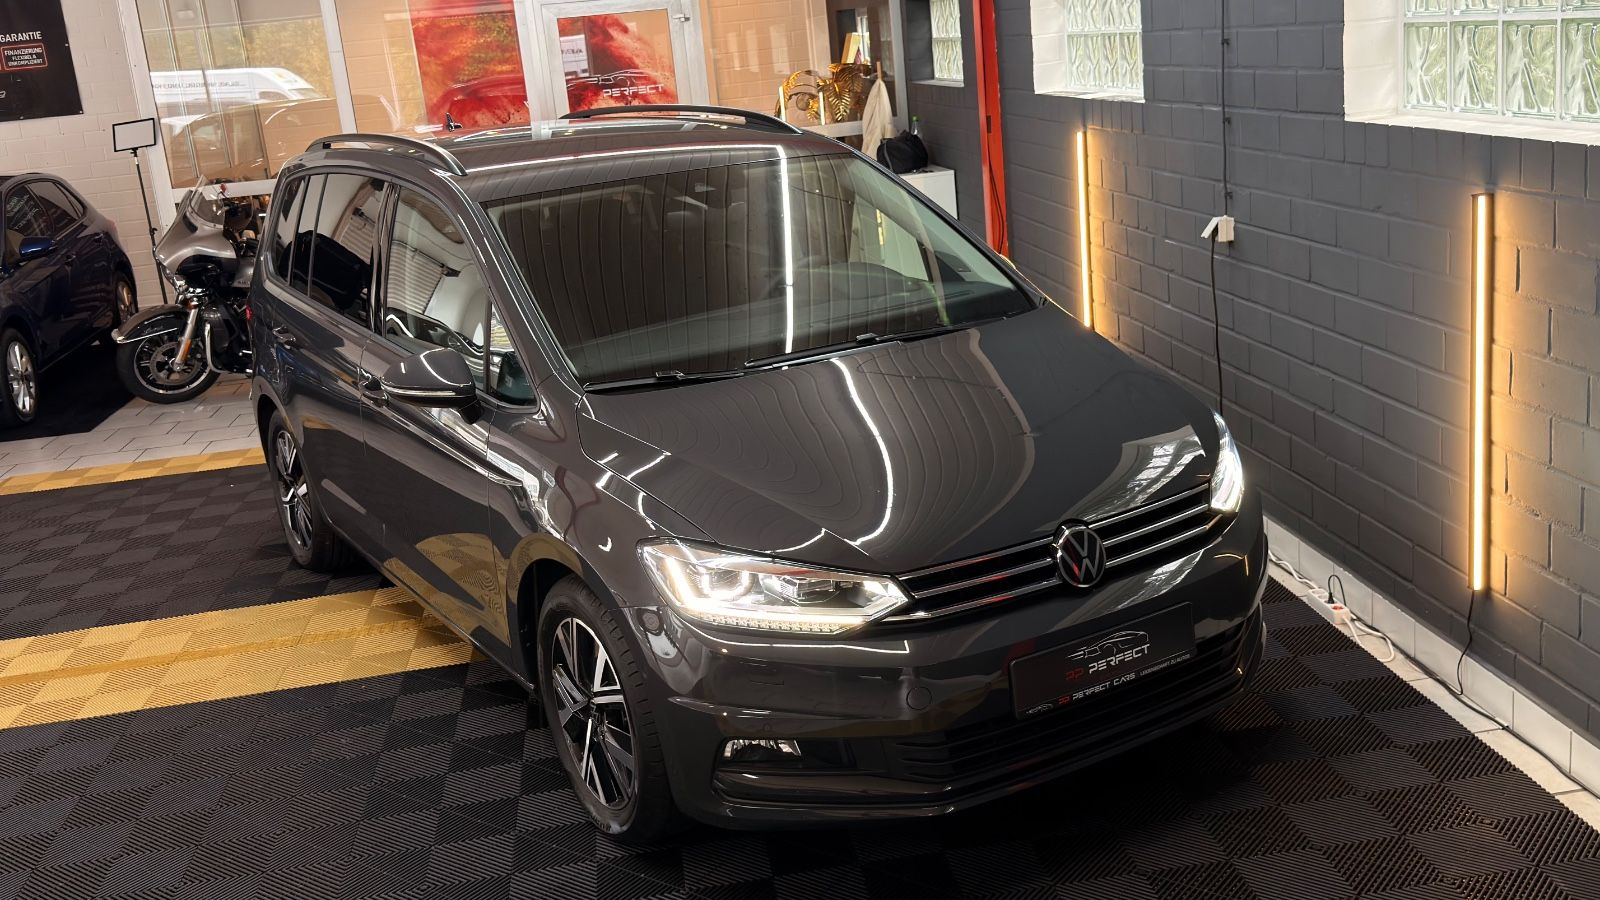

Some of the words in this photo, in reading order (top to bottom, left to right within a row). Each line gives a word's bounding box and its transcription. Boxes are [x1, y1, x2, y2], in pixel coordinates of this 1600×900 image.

[0, 31, 42, 42] GARANTIE
[4, 48, 42, 56] FINANZIERUNG
[602, 84, 664, 98] PERFECT
[1088, 643, 1151, 675] PERFECT
[1072, 681, 1111, 701] PERFECT
[1113, 672, 1136, 687] CARS
